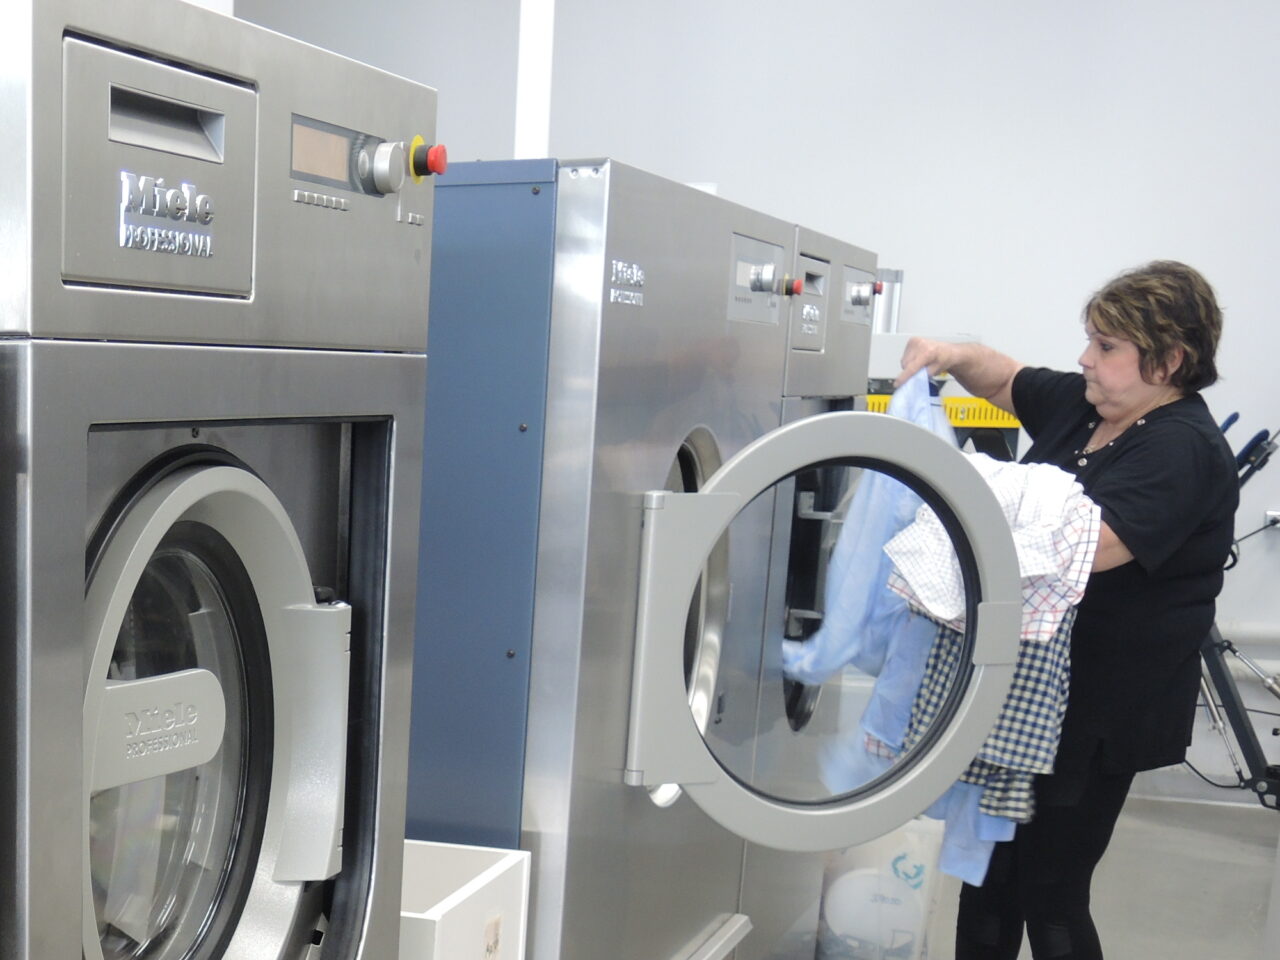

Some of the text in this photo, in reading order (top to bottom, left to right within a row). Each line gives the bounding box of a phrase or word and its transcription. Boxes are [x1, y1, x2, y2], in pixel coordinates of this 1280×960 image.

[120, 170, 214, 226] Miele
[120, 223, 214, 258] PROFESSIONAL
[124, 702, 198, 739] Miele
[125, 729, 200, 760] PROFESSIONAL
